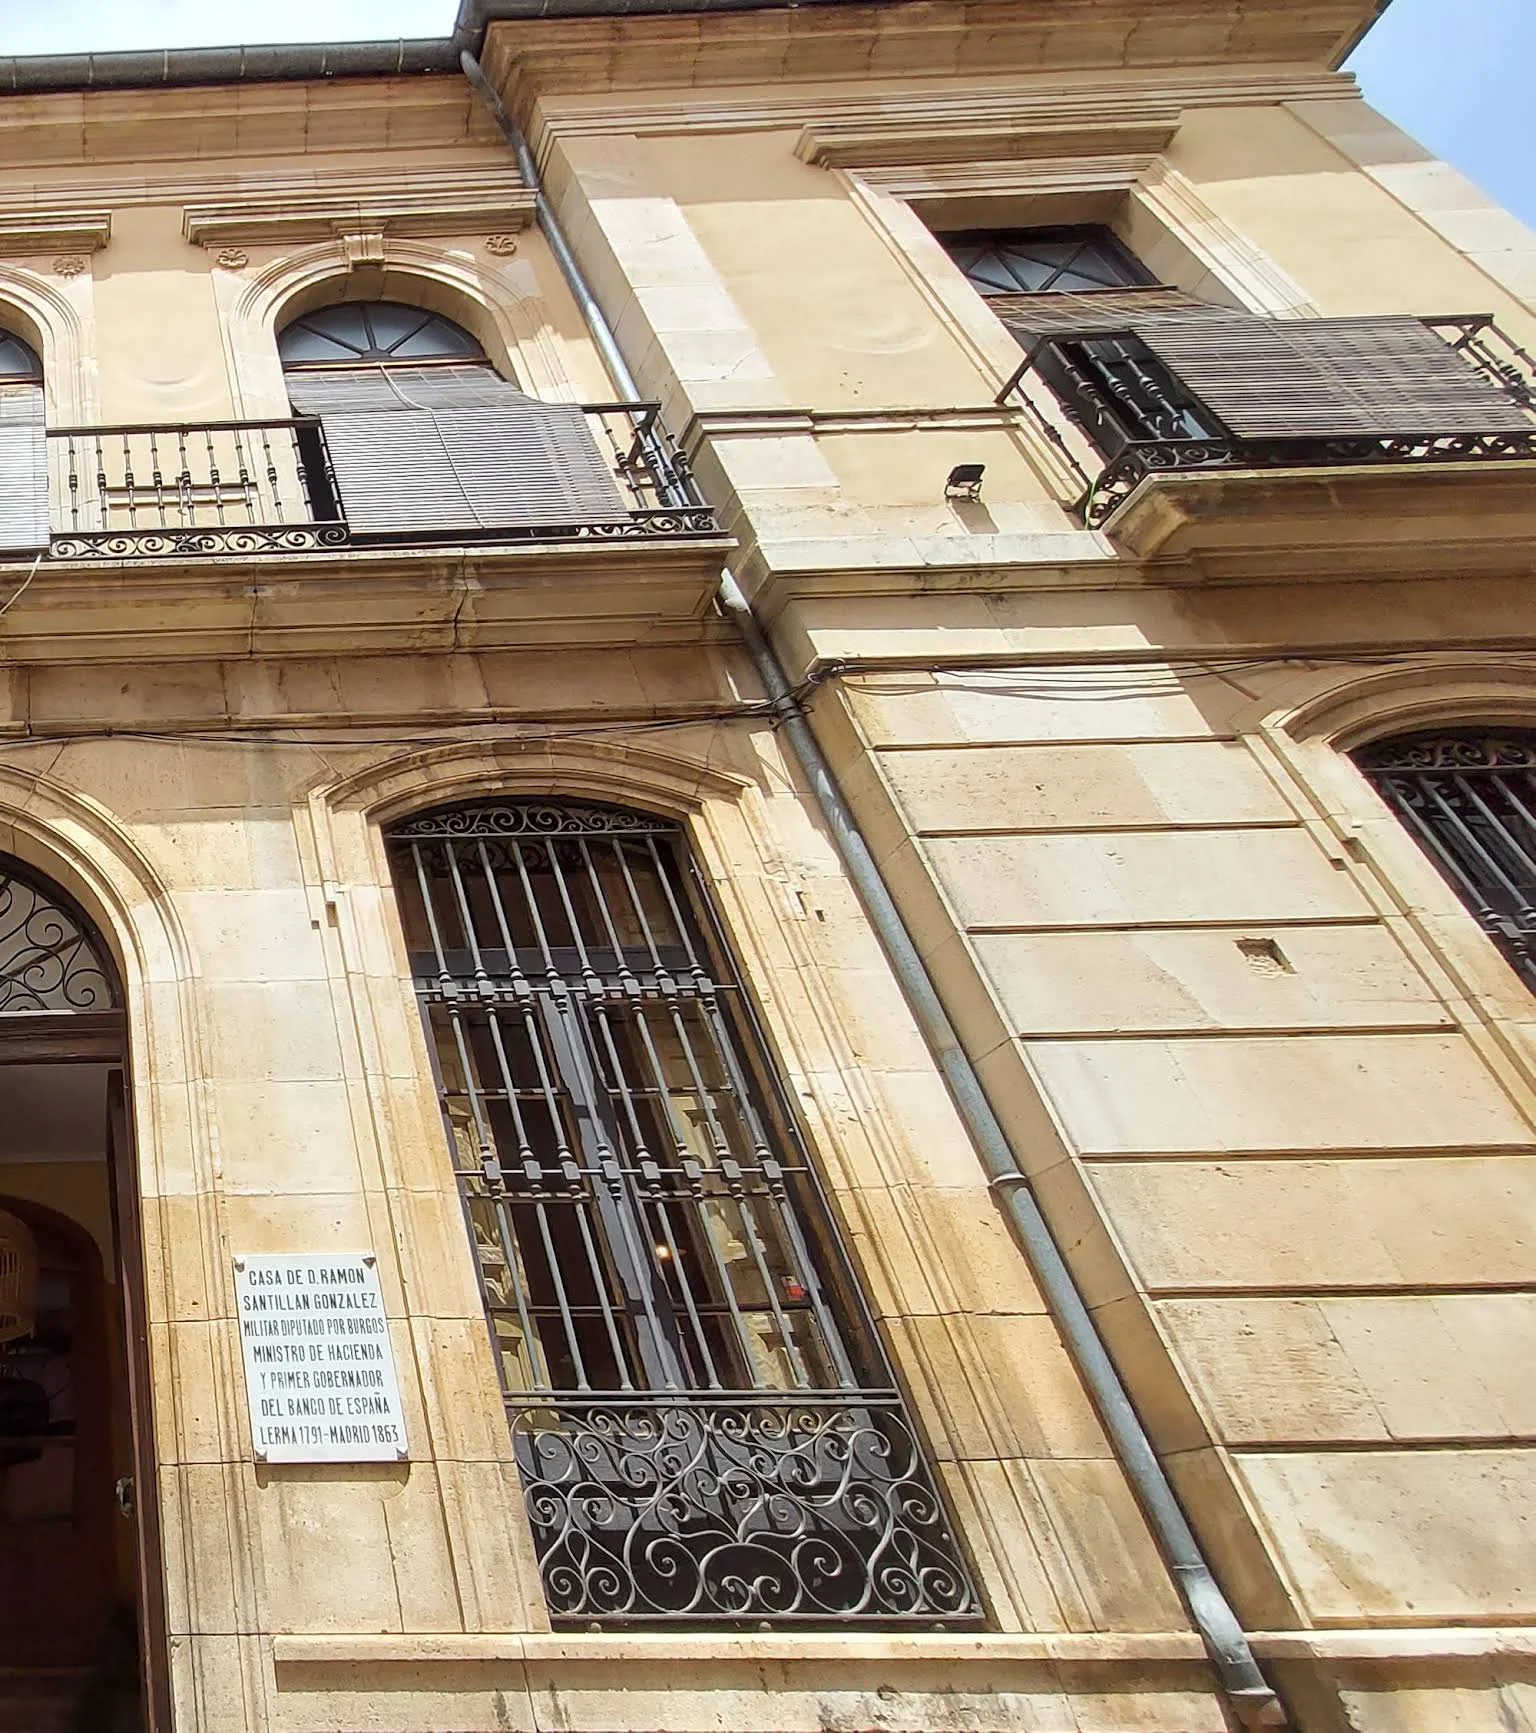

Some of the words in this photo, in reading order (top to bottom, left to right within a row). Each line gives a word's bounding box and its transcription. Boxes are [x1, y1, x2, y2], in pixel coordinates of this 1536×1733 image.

[249, 1269, 282, 1285] CASA
[287, 1269, 303, 1285] DE
[244, 1294, 310, 1311] SANTILLAN
[314, 1293, 378, 1309] GONZALEZ
[244, 1320, 279, 1337] MILITAR
[282, 1319, 325, 1335] DIPUTADO
[327, 1318, 345, 1335] POR
[348, 1318, 385, 1334] BURGOS
[253, 1346, 305, 1363] MINISTRO
[310, 1345, 325, 1361] DE
[328, 1344, 383, 1360] HACIENDA
[260, 1372, 266, 1390] Y
[271, 1371, 310, 1389] PRIMER
[314, 1370, 384, 1388] GOBERNADOR
[262, 1400, 284, 1416] DEL
[289, 1399, 325, 1416] BANCO
[329, 1398, 344, 1415] DE
[347, 1392, 391, 1415] ESPAÑA
[372, 1425, 398, 1442] 1863
